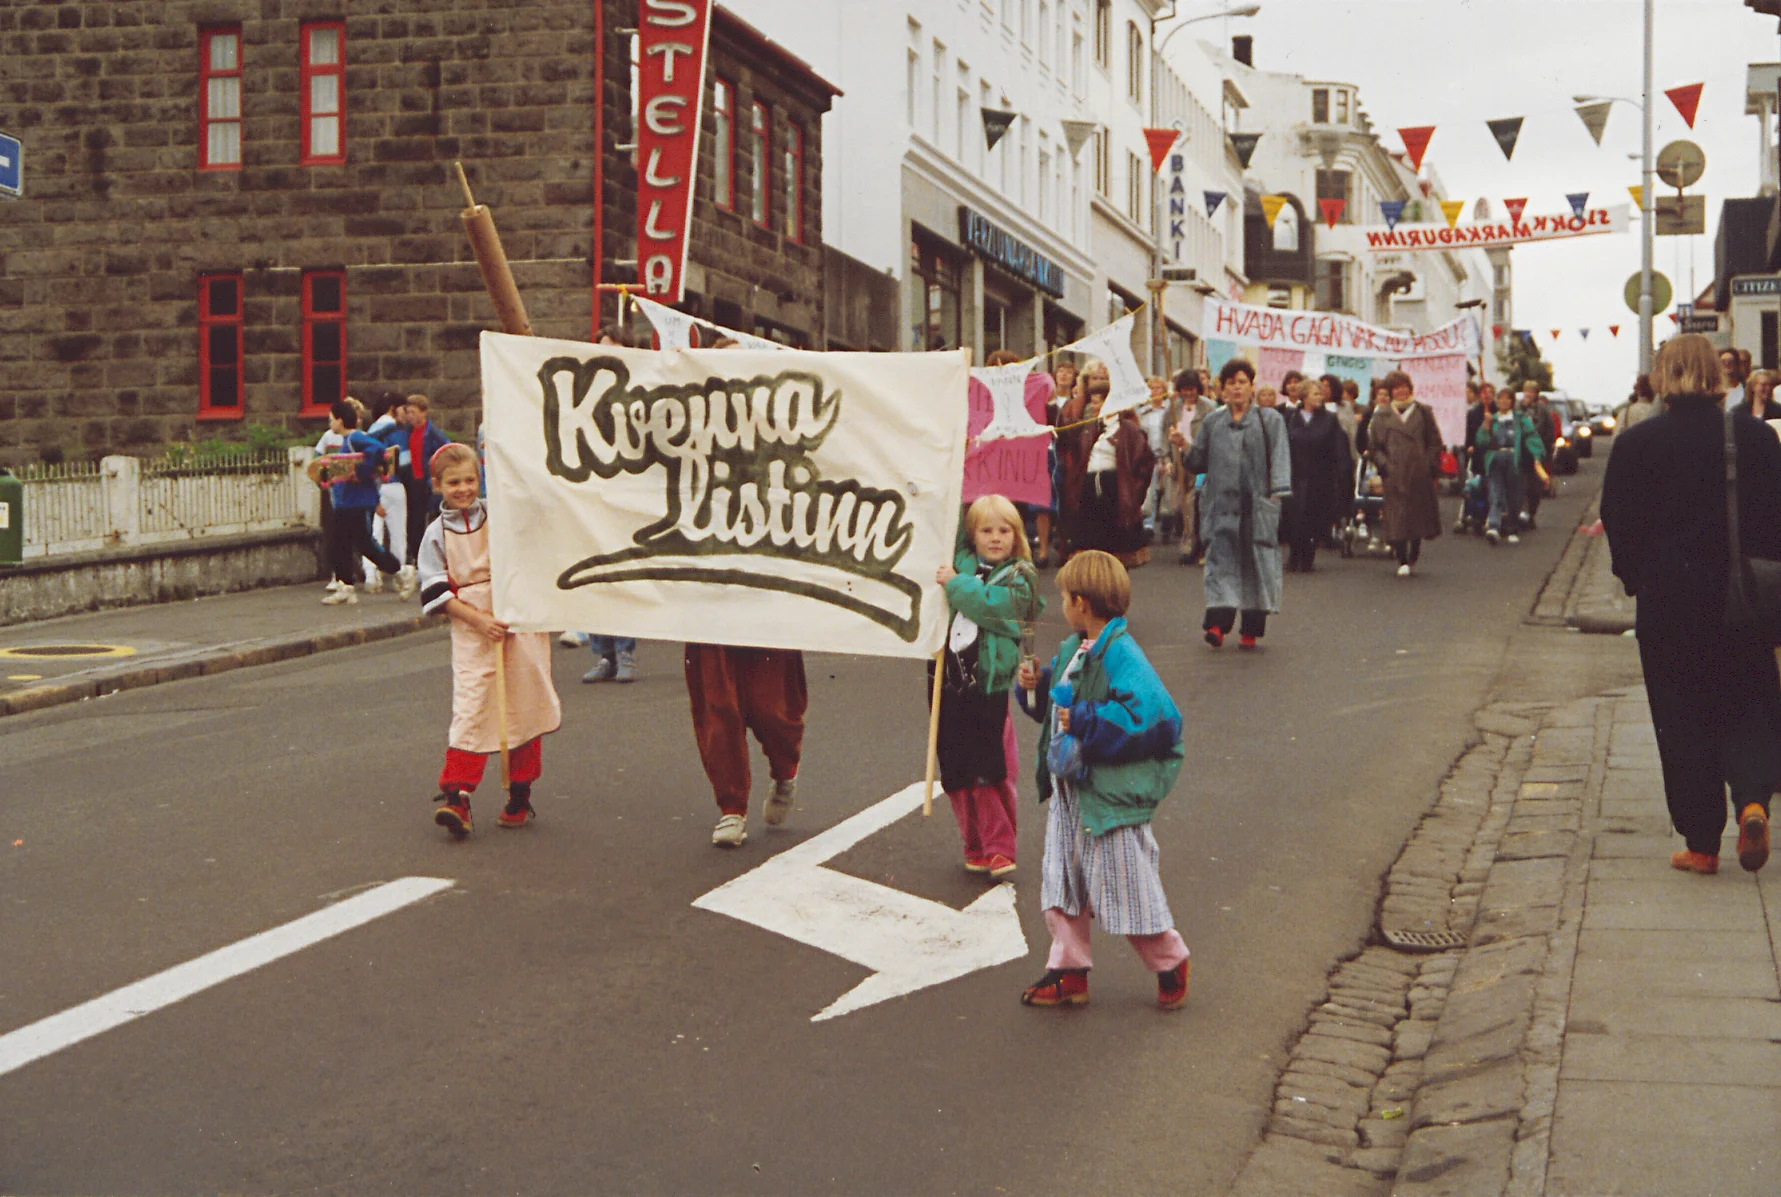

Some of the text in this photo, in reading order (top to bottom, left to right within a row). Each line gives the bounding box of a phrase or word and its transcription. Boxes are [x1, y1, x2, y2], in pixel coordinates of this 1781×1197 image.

[645, 0, 696, 295] STELLA
[1170, 154, 1185, 260] BANKI
[1216, 305, 1286, 340] HVAÐA
[1291, 316, 1344, 349] GAGN
[538, 356, 842, 483] Kvenna
